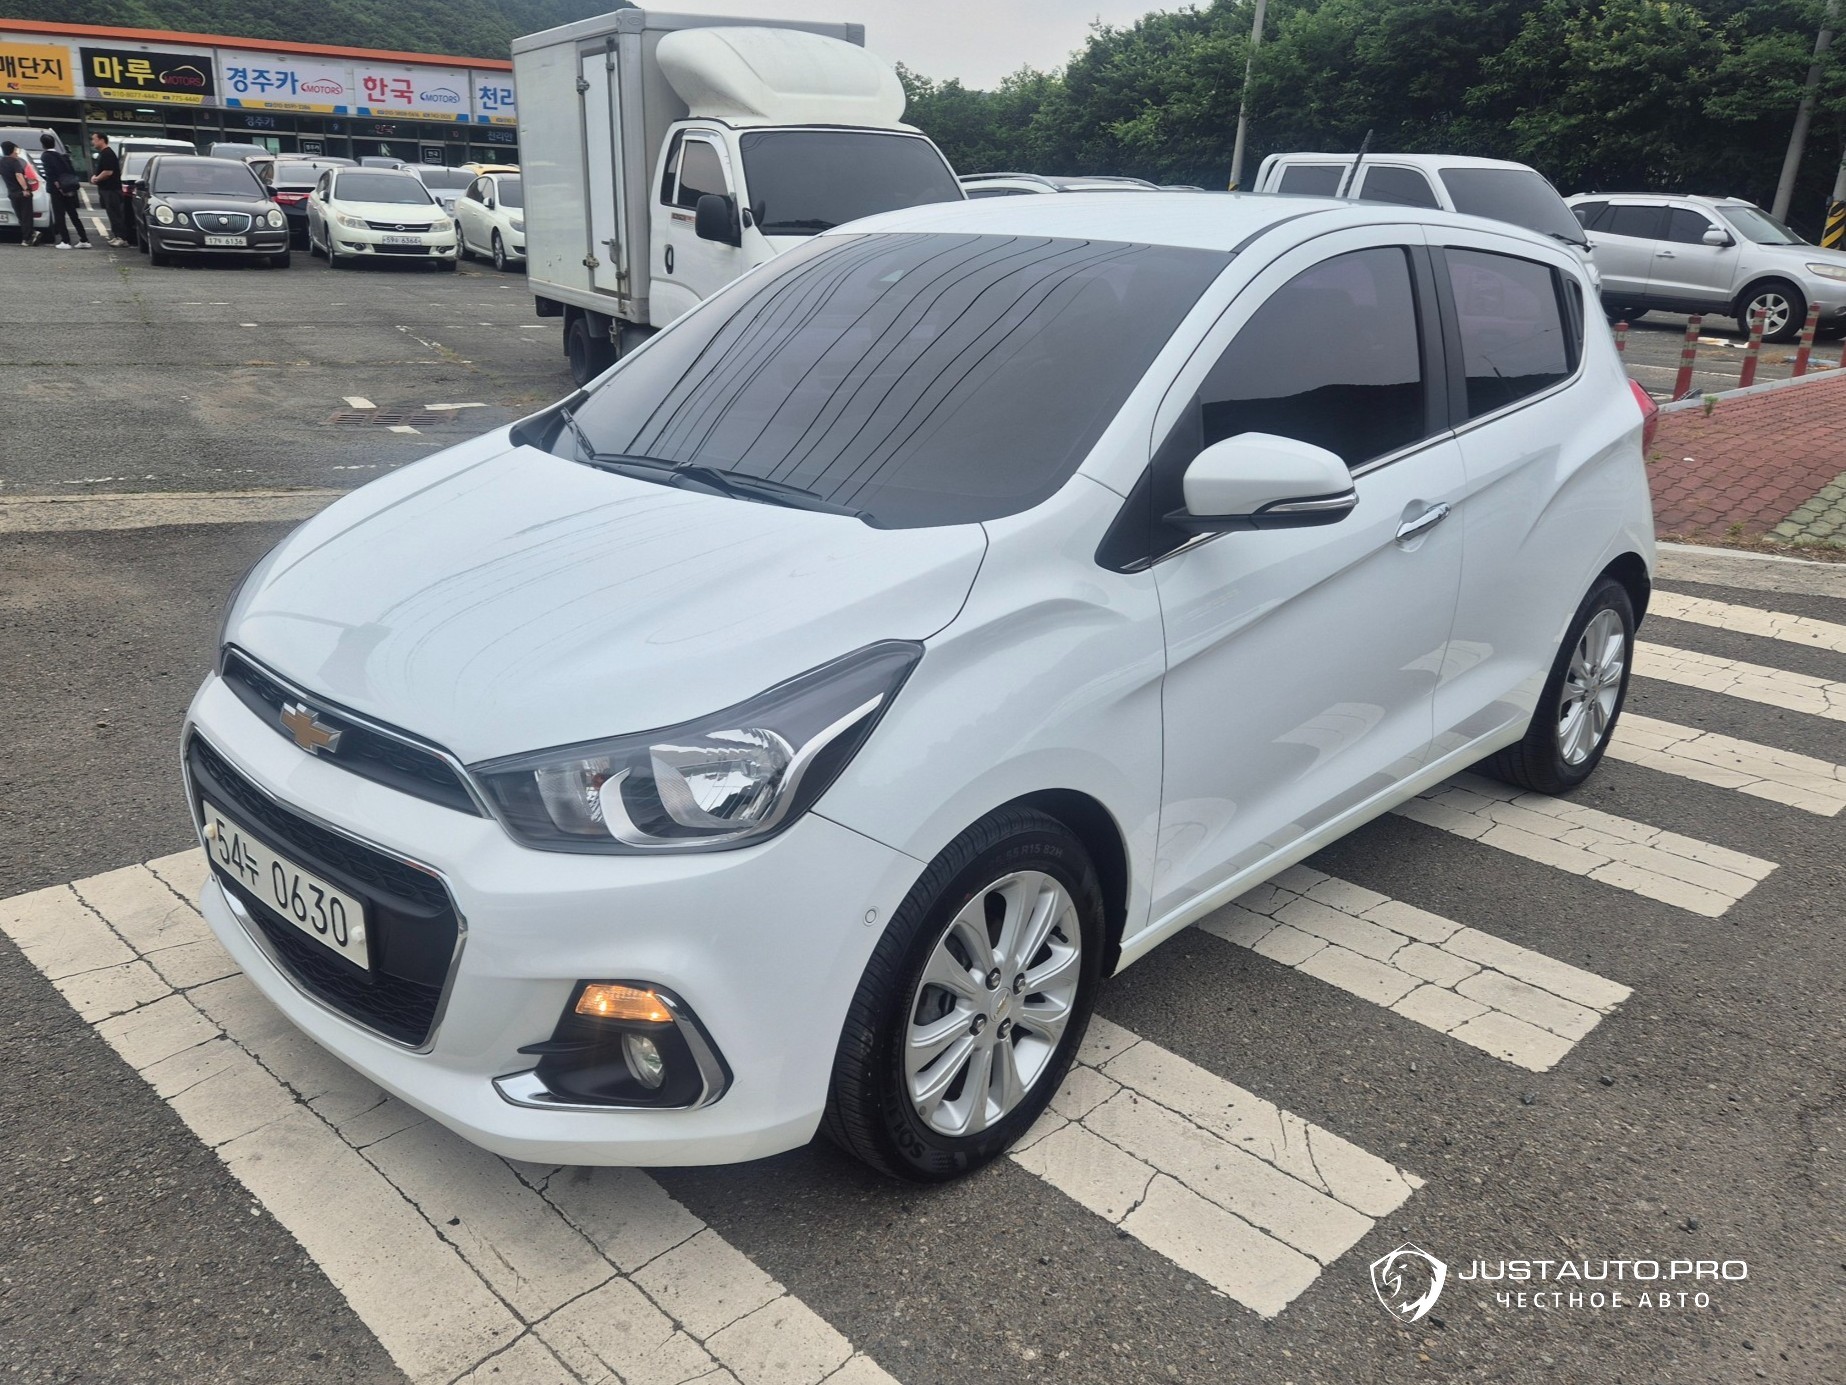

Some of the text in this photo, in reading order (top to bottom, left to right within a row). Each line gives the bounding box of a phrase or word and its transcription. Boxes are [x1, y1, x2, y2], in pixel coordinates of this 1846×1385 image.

[93, 56, 202, 87] 마루 MOTORS
[226, 67, 341, 95] 경주카 MOTORS
[363, 76, 459, 105] 한국 MOTORS
[245, 115, 275, 127] 경주카
[332, 123, 339, 131] 9
[487, 131, 514, 142] 천리안
[216, 818, 348, 947] 54누 0630
